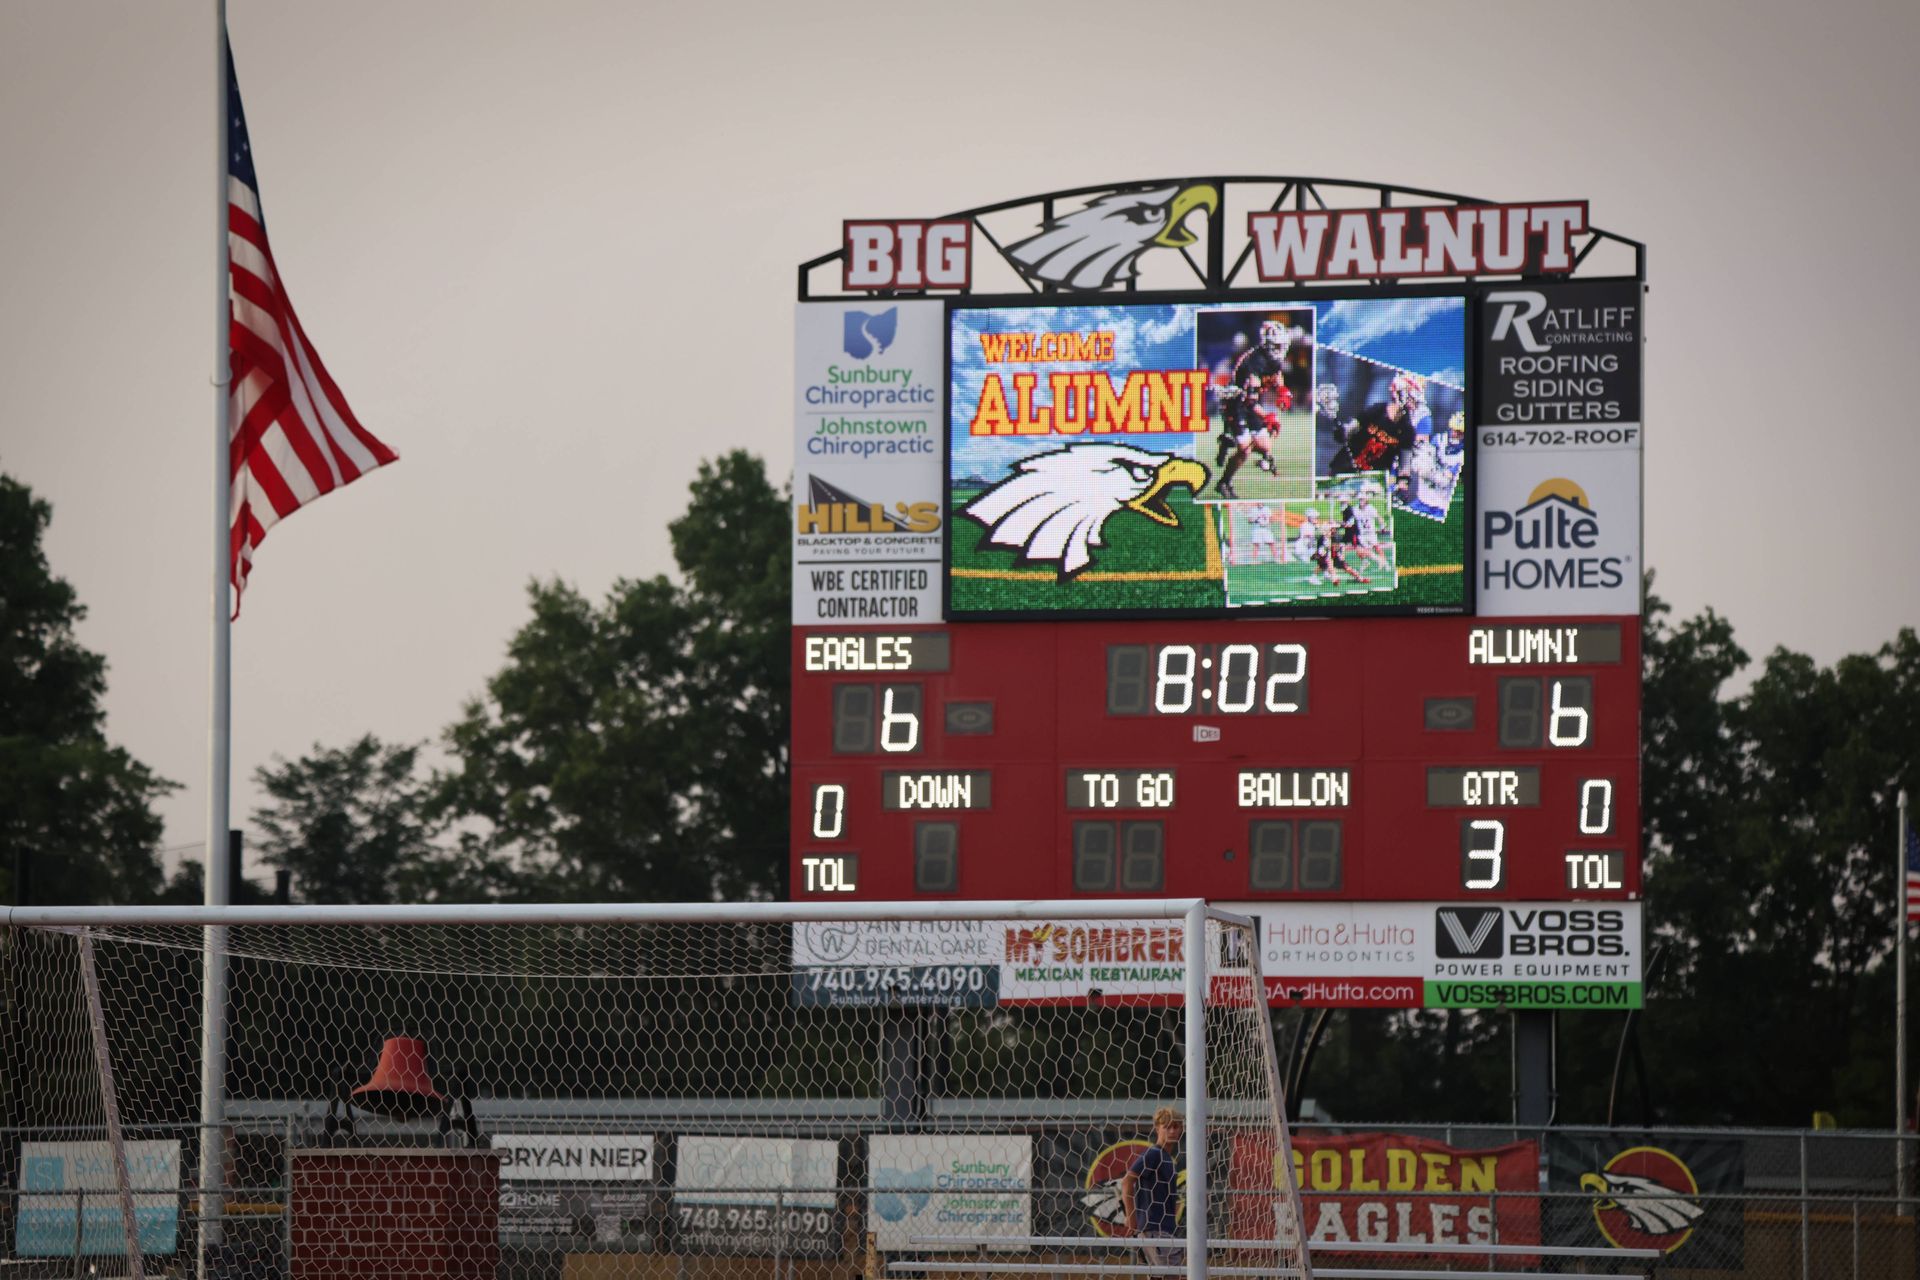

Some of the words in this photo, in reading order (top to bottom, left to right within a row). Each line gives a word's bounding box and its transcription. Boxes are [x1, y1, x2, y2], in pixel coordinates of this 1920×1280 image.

[846, 222, 969, 288] BIG
[1252, 203, 1586, 280] WALNUT
[980, 331, 1115, 364] WELCOME
[1545, 331, 1633, 345] CONTRACTING
[1500, 354, 1619, 375] ROOFING
[827, 365, 912, 390] Sunbury
[1513, 378, 1604, 398] SIDING
[806, 385, 934, 408] Chiropractic
[970, 368, 1209, 436] ALUMNI
[1497, 401, 1620, 422] GUTTERS
[815, 416, 927, 436] Johnstown
[1482, 428, 1638, 447] 614-702-ROOF
[807, 436, 933, 459] Chiropractic
[798, 502, 941, 535] HILL'S
[1484, 505, 1600, 550] Pulte
[797, 537, 861, 546] BLACKTOP
[863, 537, 872, 545] &
[874, 536, 941, 546] CONCRETE
[886, 547, 926, 555] FUTURE
[811, 570, 844, 591] WBE
[851, 569, 928, 590] CERTIFIED
[1484, 557, 1623, 590] HOMES
[817, 596, 918, 618] CONTRACTOR
[805, 636, 912, 671] EAGLES
[1469, 628, 1579, 664] ALUMNI
[1155, 644, 1307, 714] 8:02
[880, 687, 919, 752] 6
[1548, 680, 1588, 748] 6
[899, 774, 971, 809] DOWN
[1083, 773, 1119, 808] TO
[1137, 773, 1173, 807] GO
[1462, 770, 1519, 806] QTR
[813, 784, 845, 839] 0
[1579, 779, 1612, 835] 0
[1465, 819, 1504, 889] 3
[802, 858, 855, 892] TOL
[1565, 854, 1622, 889] TOL
[1509, 910, 1624, 932] VOSS
[865, 939, 931, 955] DENTAL
[941, 939, 987, 955] CARE
[1053, 927, 1186, 964] SOMBRER
[1267, 951, 1415, 962] ORTHODONTICS
[1509, 934, 1630, 956] BROS.
[808, 966, 984, 992] 740.965.4090
[1015, 967, 1083, 982] MEXICAN
[1090, 967, 1186, 982] RESTAURAN
[1435, 963, 1503, 976] POWER
[1514, 963, 1630, 977] EQUIPMENT
[1436, 984, 1628, 1005] VOSSBROS.COM
[497, 1147, 582, 1167] BRYAN
[590, 1147, 648, 1168] NIER
[951, 1160, 1011, 1176] Sunbury
[937, 1174, 1025, 1189] Chiropractic
[944, 1195, 1020, 1210] Johnstown
[937, 1210, 1024, 1226] Chiropractic
